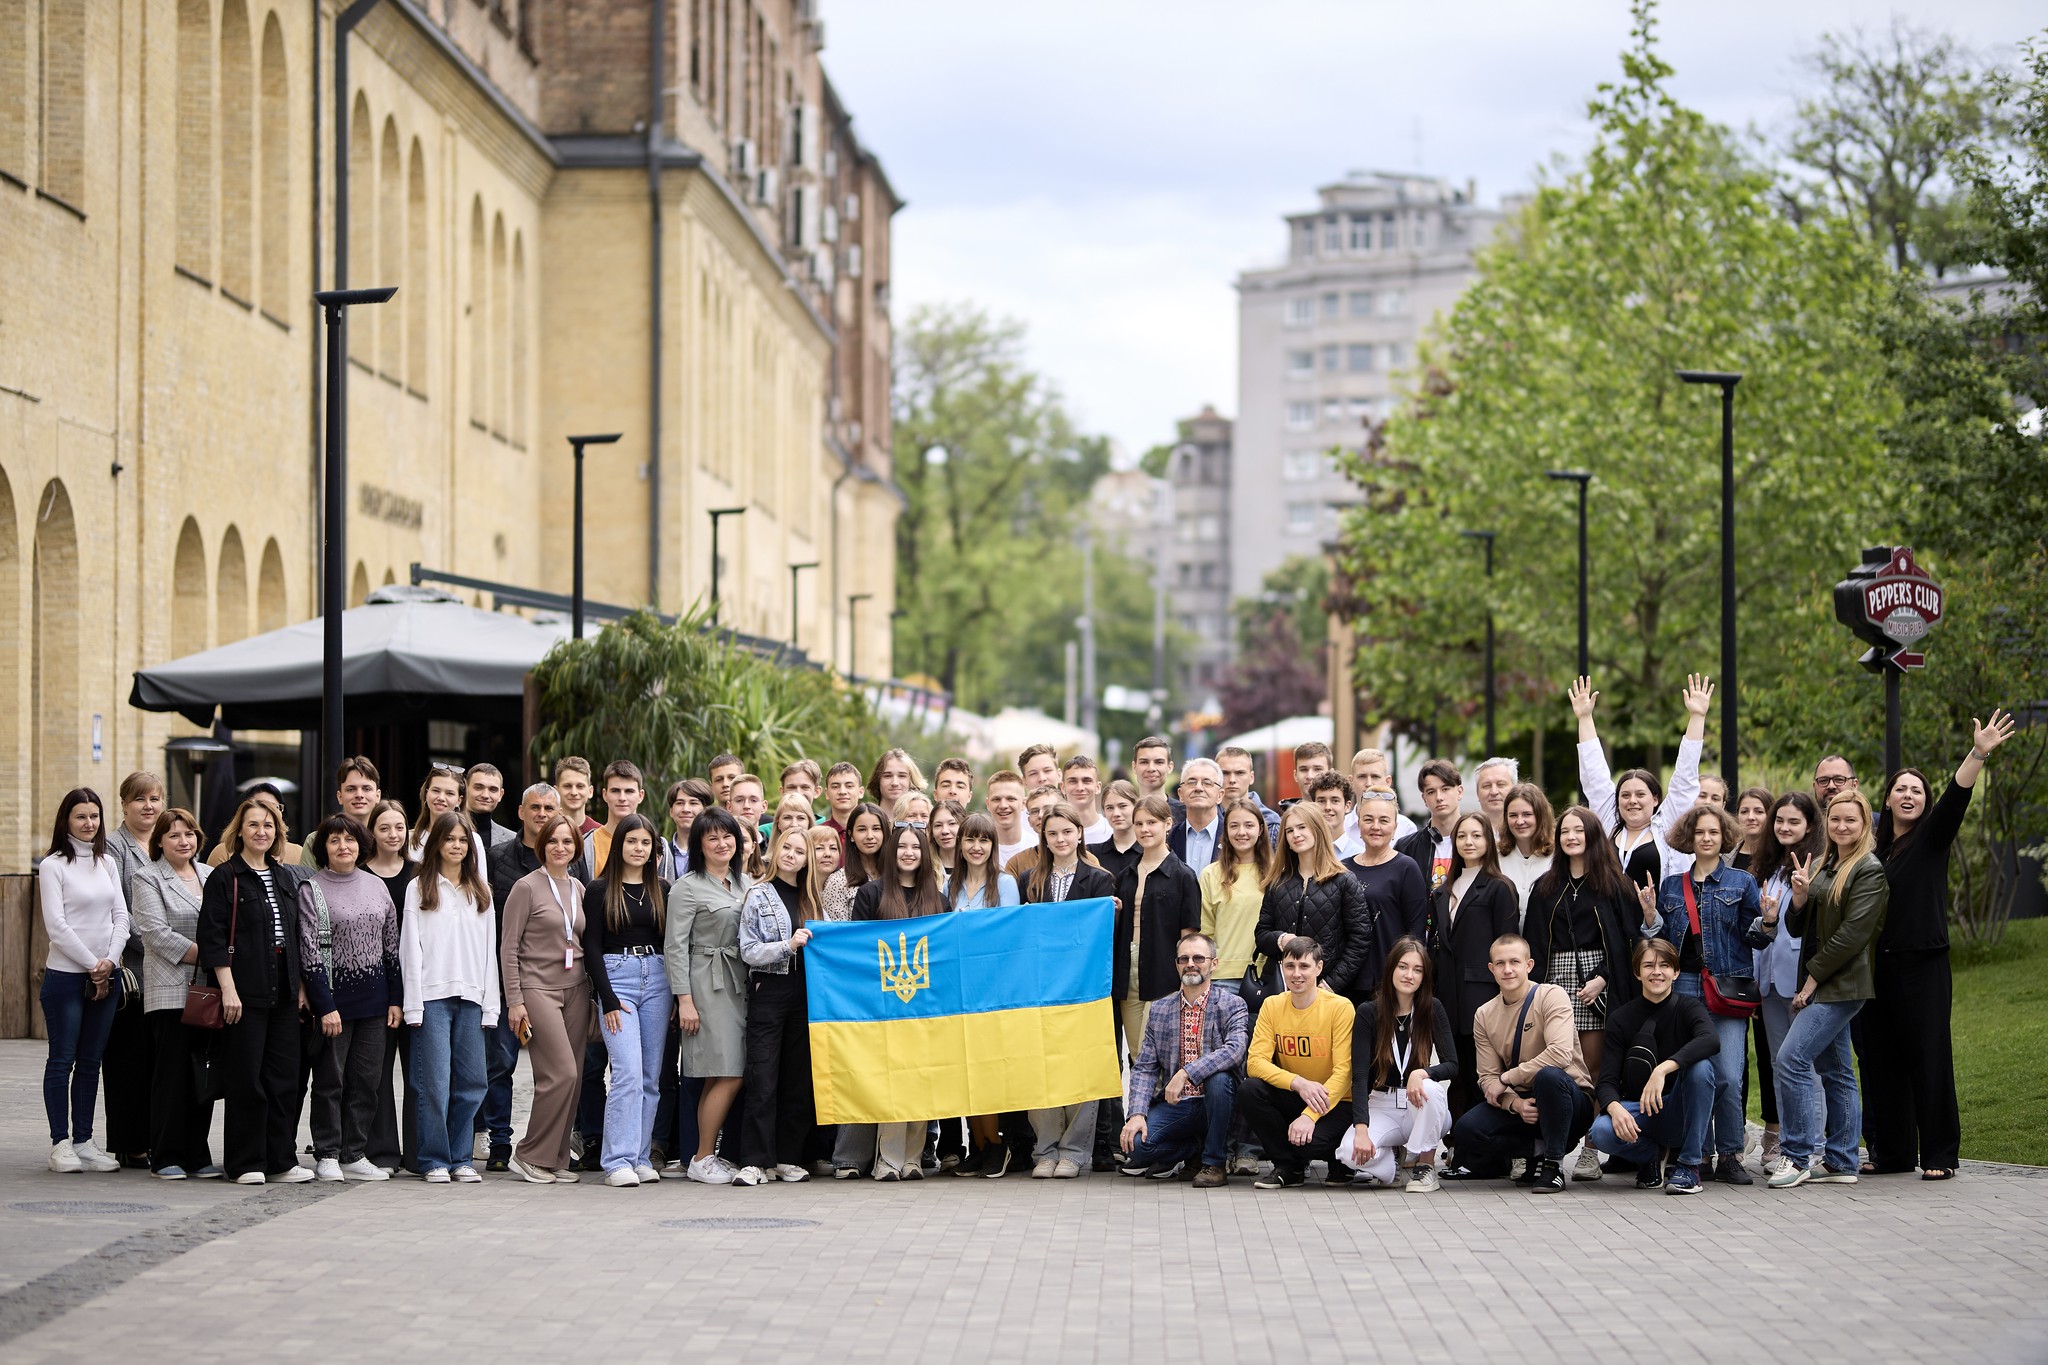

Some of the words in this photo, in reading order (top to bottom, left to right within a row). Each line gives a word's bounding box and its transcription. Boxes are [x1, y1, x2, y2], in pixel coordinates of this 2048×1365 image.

[1869, 581, 1912, 615] PEPPER'S
[1915, 584, 1939, 615] CLUB
[1888, 620, 1908, 636] MUSIC
[1909, 621, 1923, 635] PUB
[1275, 1033, 1328, 1057] ICON
